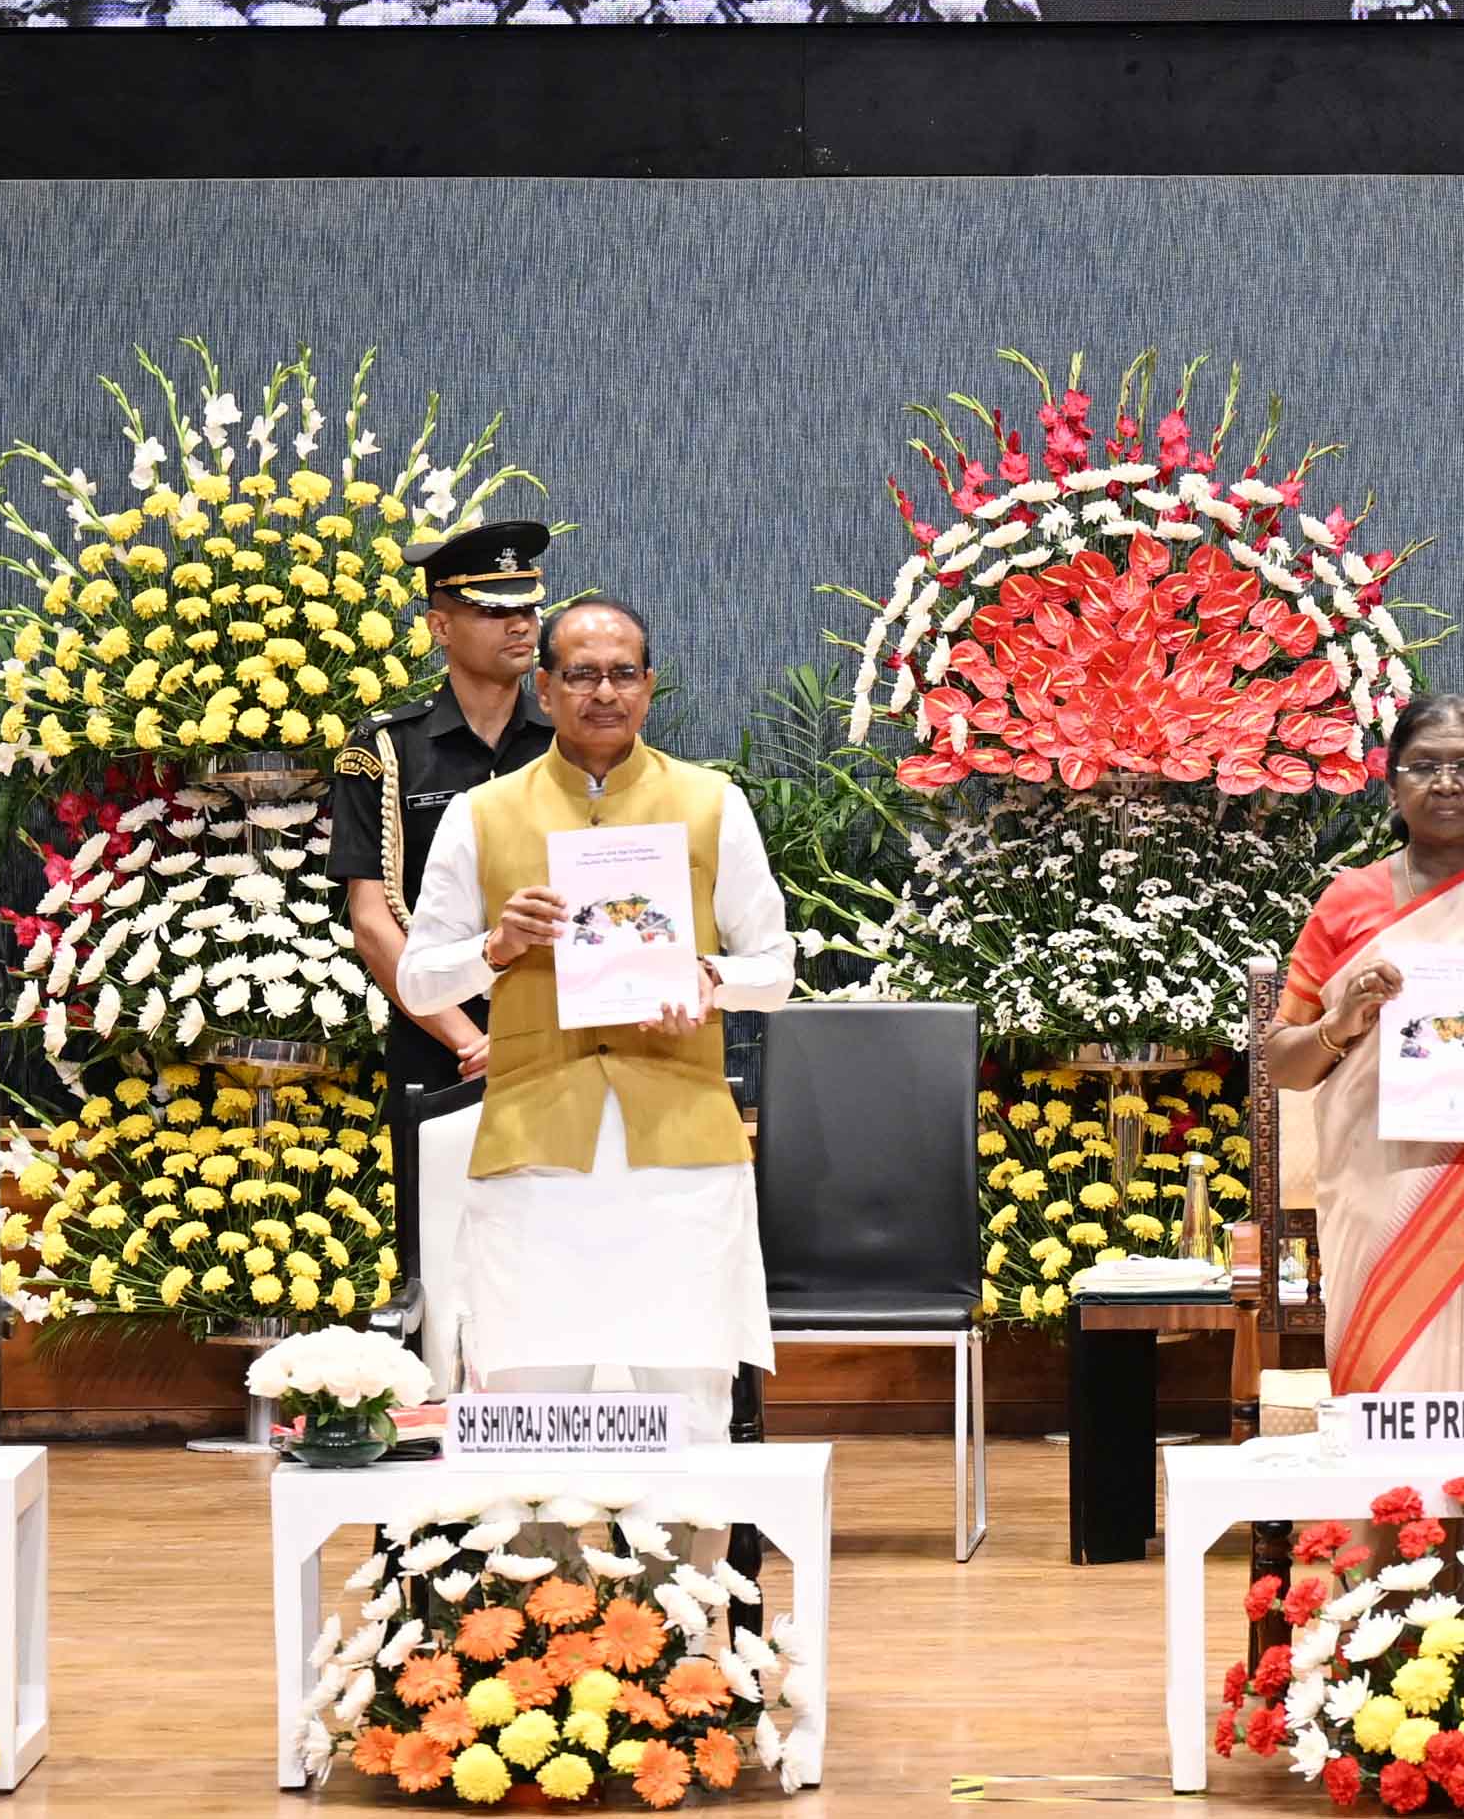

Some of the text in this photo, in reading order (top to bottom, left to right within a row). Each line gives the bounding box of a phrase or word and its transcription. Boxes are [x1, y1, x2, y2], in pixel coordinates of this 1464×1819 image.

[458, 1406, 667, 1443] SH SHIVRAJ SINGH CHOUHAN
[1362, 1401, 1415, 1439] THE
